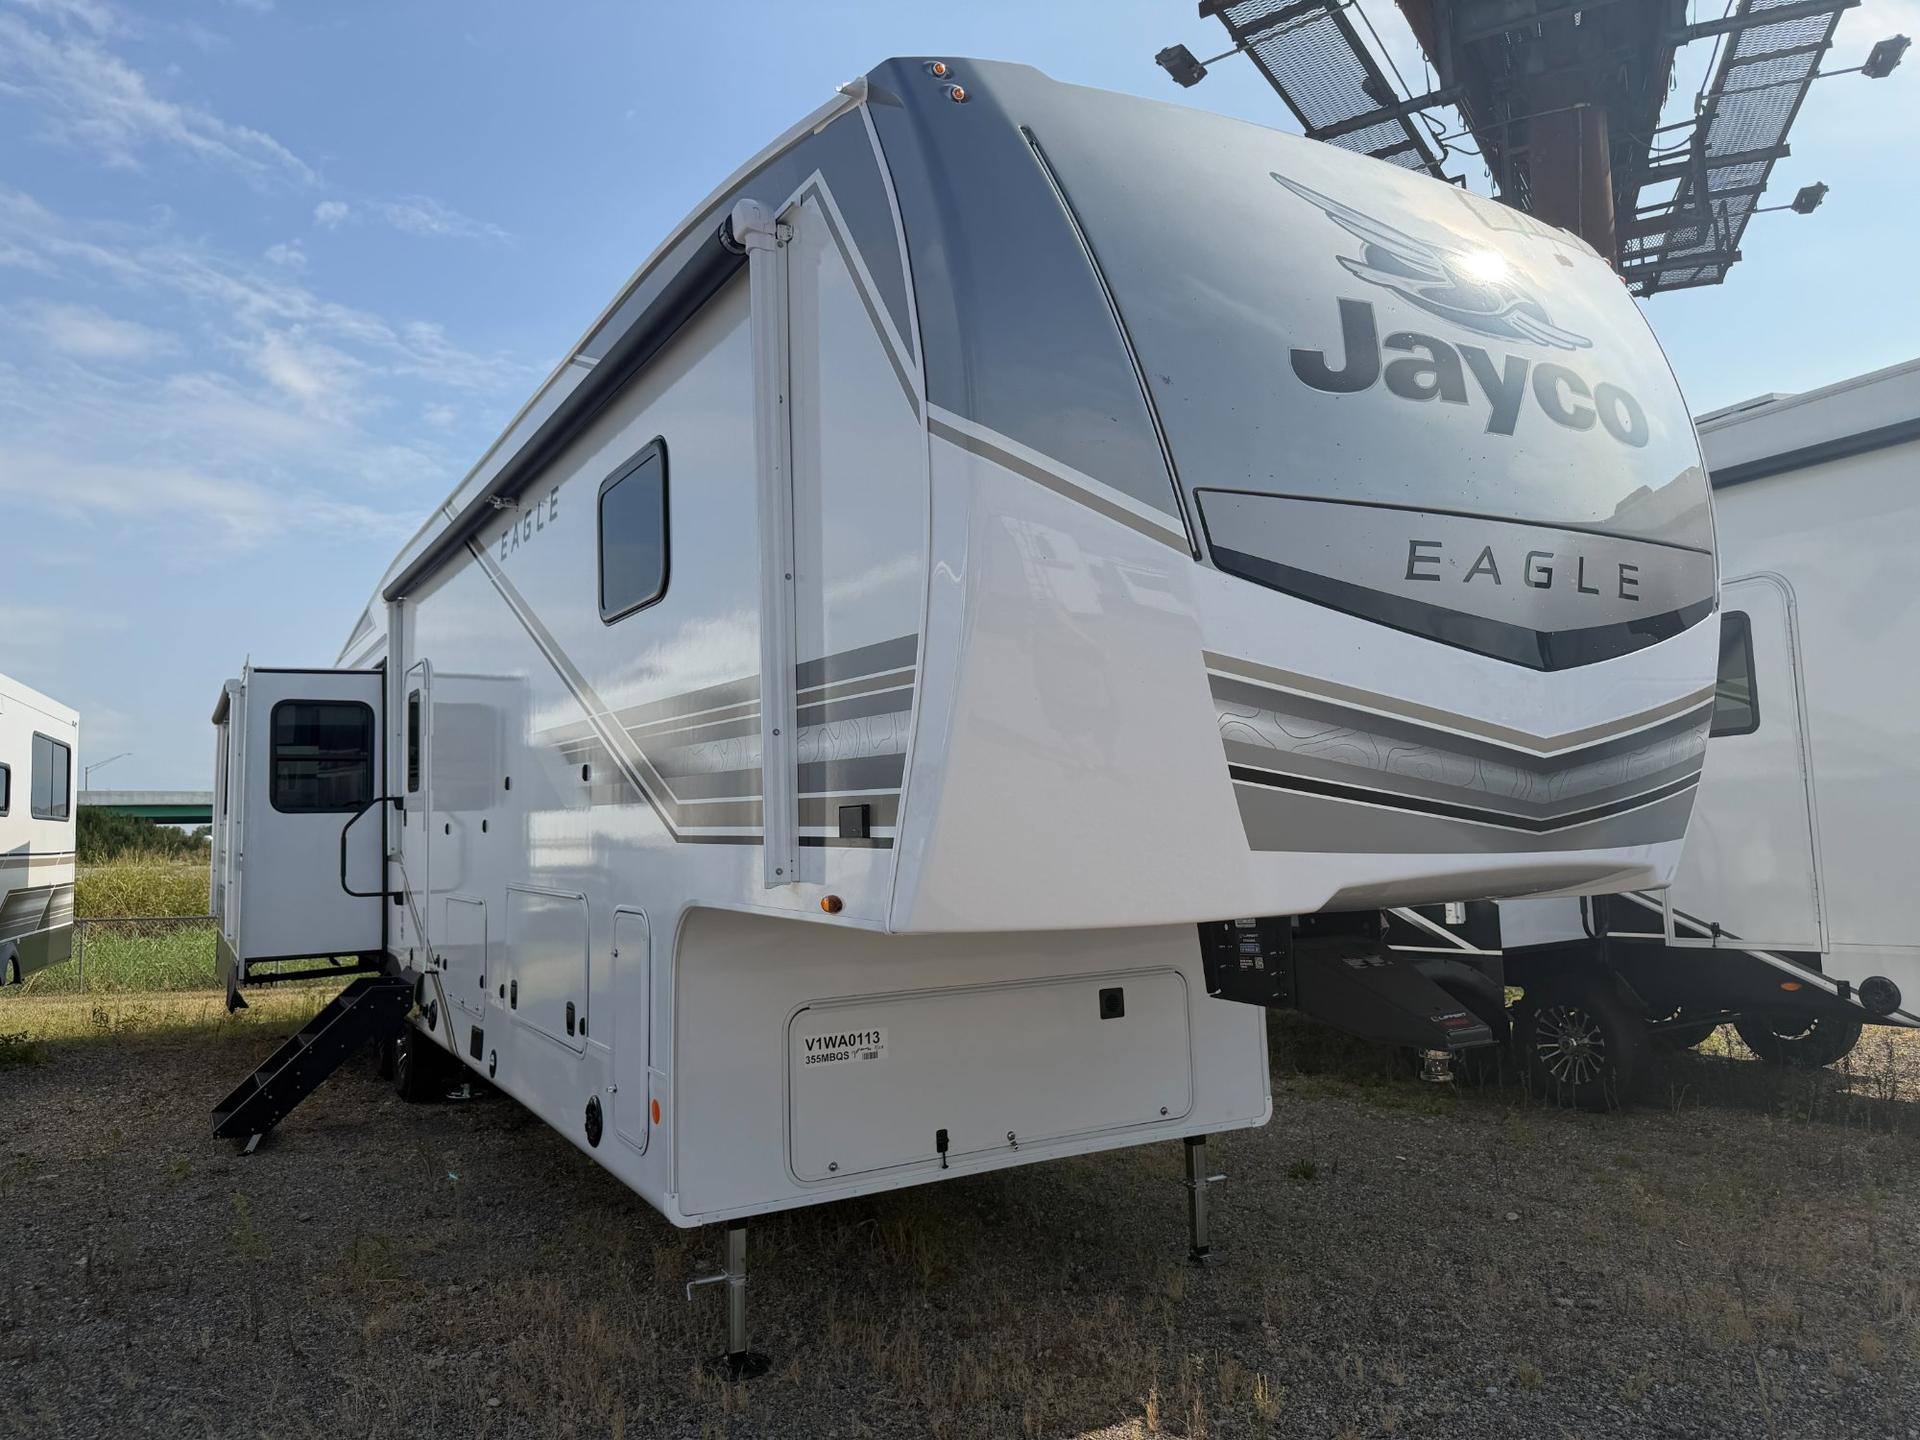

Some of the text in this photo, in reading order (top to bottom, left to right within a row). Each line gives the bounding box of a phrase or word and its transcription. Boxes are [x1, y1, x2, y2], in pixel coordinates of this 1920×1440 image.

[1288, 296, 1650, 448] Jayco
[501, 486, 559, 561] EAGLE
[1404, 540, 1641, 602] EAGLE
[805, 1031, 880, 1051] V1WA0113
[805, 1051, 850, 1064] 355MBQS
